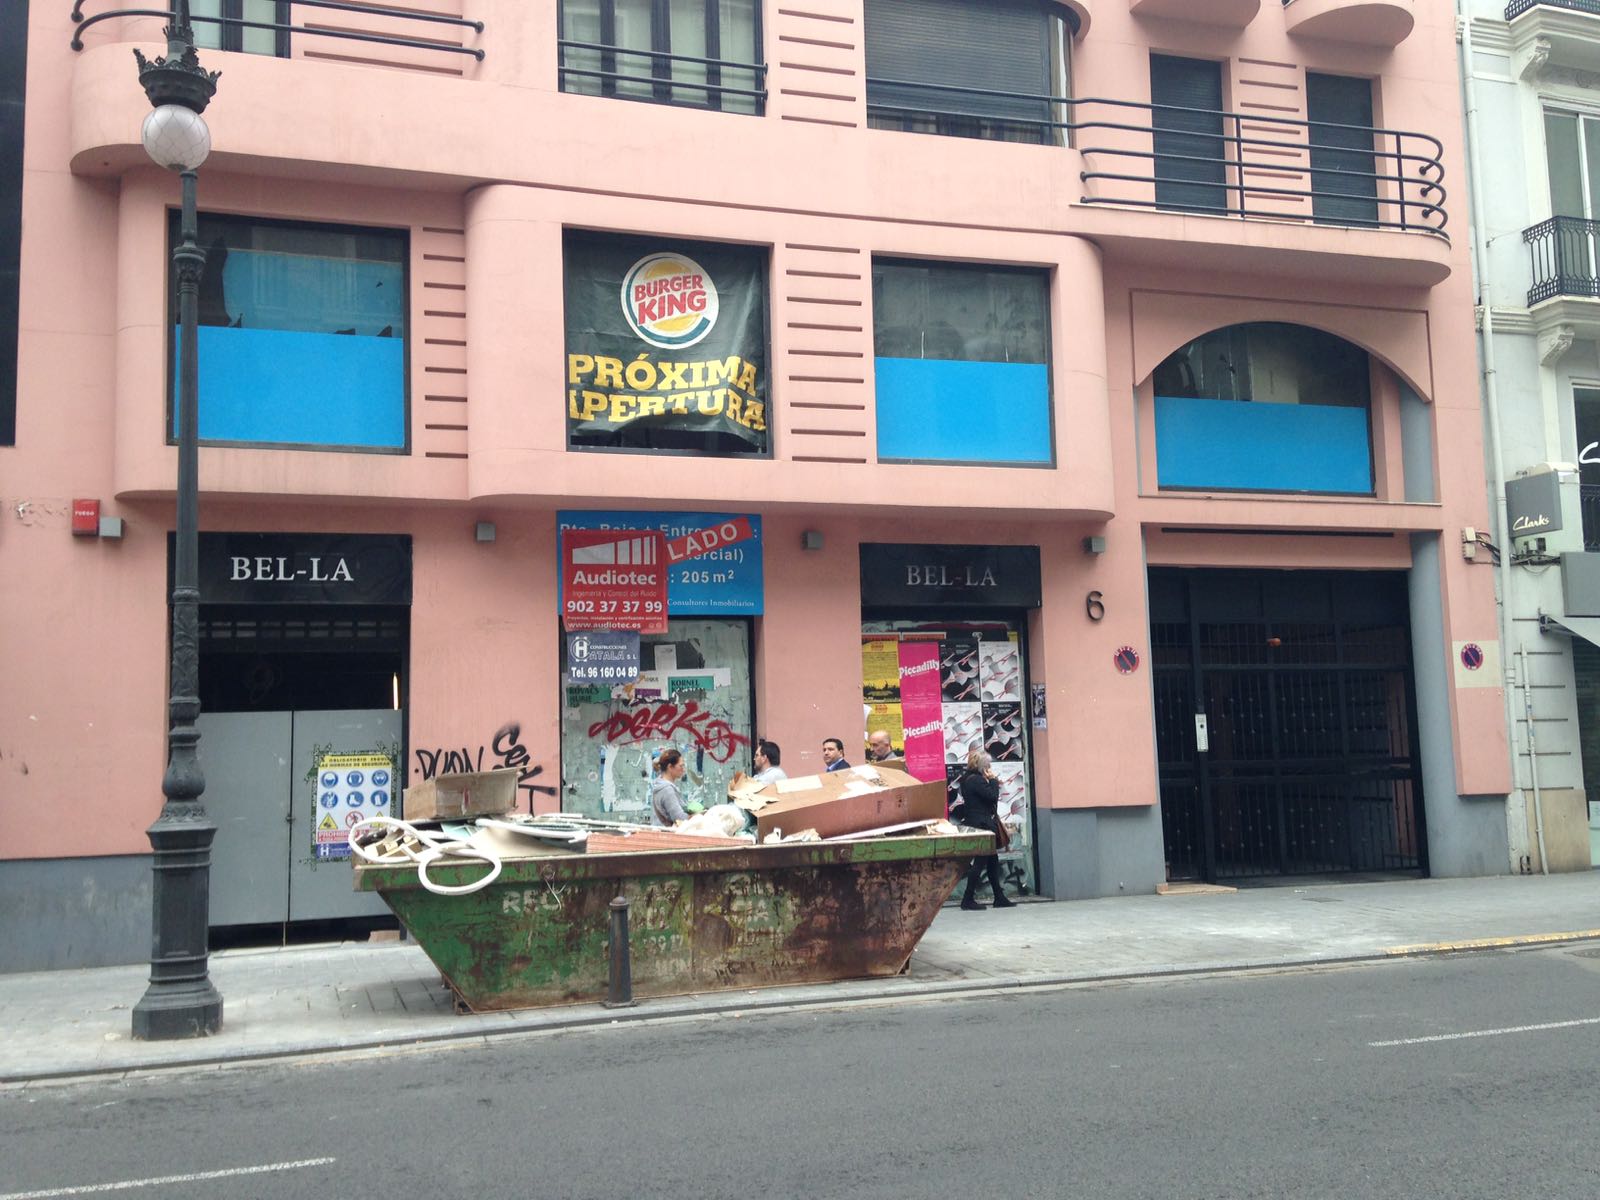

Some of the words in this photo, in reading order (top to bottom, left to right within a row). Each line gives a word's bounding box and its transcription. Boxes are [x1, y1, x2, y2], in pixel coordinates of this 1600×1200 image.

[634, 274, 704, 302] BURGER
[637, 290, 707, 325] KING
[568, 353, 758, 397] PRÓXIMA
[1512, 514, 1550, 531] Clarks
[230, 557, 355, 581] BEL-LA
[572, 570, 657, 585] Audiotec
[681, 570, 709, 583] 205
[906, 565, 998, 586] BEL-LA
[567, 600, 595, 613] 902
[599, 600, 618, 613] 37
[622, 600, 640, 613] 37
[645, 600, 663, 613] 99
[710, 599, 755, 608] Inmobiliarios
[1086, 590, 1105, 622] 6
[567, 621, 642, 629] www.audiotec.es
[571, 667, 587, 678] Tel.
[587, 667, 598, 678] 96
[600, 667, 615, 678] 160
[616, 667, 627, 677] 04
[627, 666, 638, 677] 89
[899, 659, 940, 679] Piccadilly
[903, 719, 944, 741] Piccadilly
